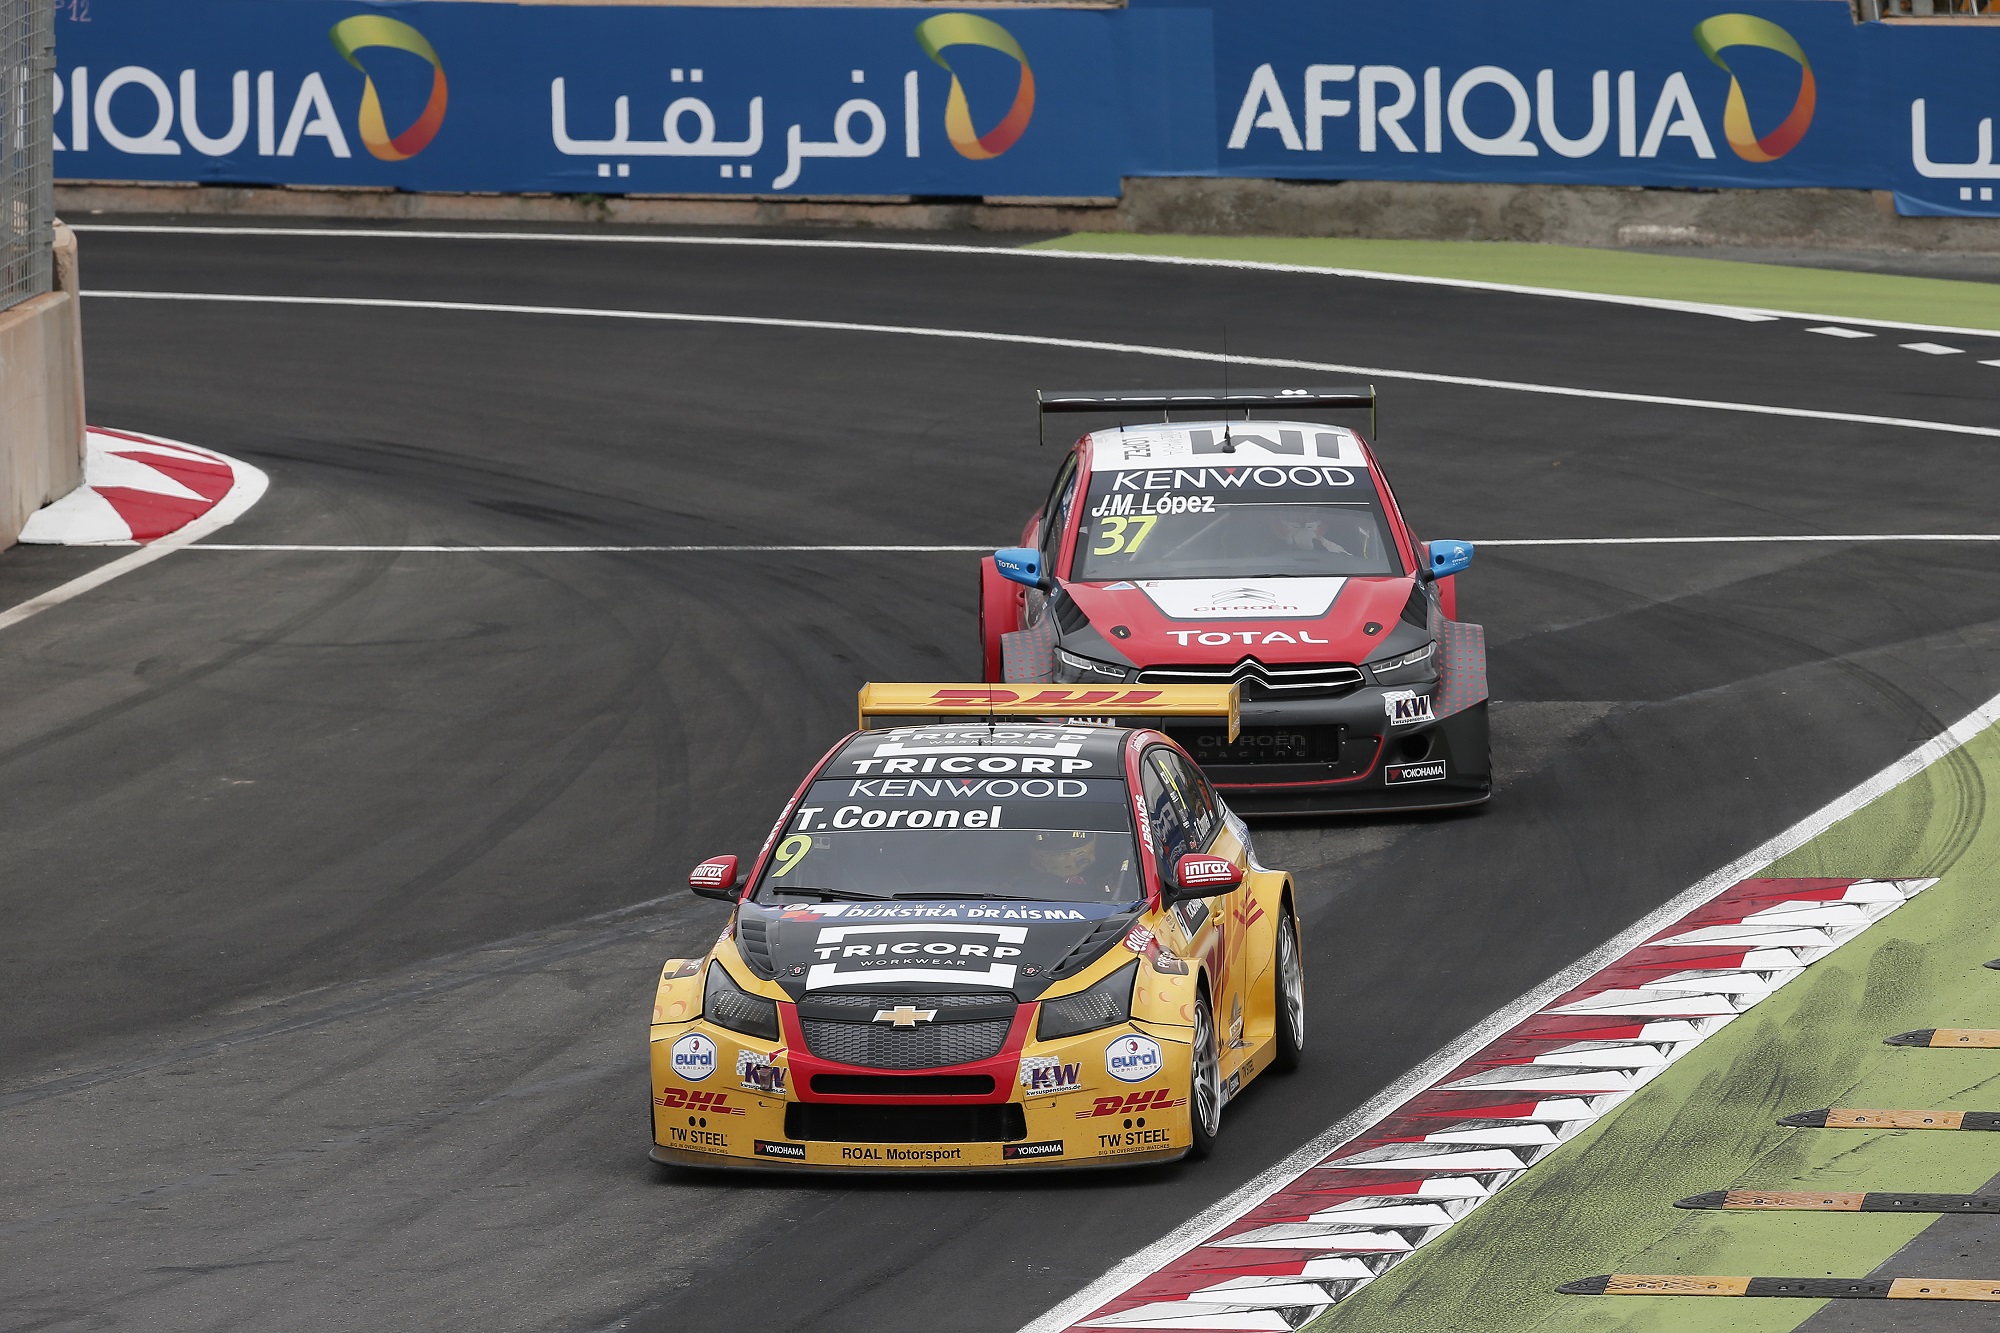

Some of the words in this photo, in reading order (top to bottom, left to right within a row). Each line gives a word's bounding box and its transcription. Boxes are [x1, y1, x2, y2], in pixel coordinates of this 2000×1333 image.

[1227, 63, 1717, 159] AFRIQUIA
[551, 69, 920, 190] افريقيا
[1112, 466, 1355, 492] KENWOOD
[1091, 493, 1136, 517] J.M.
[1141, 492, 1216, 516] López
[1093, 515, 1157, 556] 37
[997, 560, 1020, 570] TOTAL
[1166, 630, 1329, 646] TOTAL
[927, 689, 1165, 707] DHL
[1395, 697, 1429, 719] KW
[885, 731, 1089, 742] TRICORP
[852, 757, 1094, 775] TRICORP
[1401, 765, 1443, 779] YOKOHAMA
[848, 779, 1089, 798] KENWOOD
[771, 834, 813, 878] 9
[844, 907, 958, 918] DIJKSTRA
[967, 908, 1087, 920] DRAISMA
[814, 943, 1022, 960] TRICORP
[860, 958, 967, 966] WORKWEAR
[675, 1052, 713, 1066] eurol
[1111, 1050, 1157, 1069] eurol
[1032, 1063, 1081, 1090] KW
[1026, 1084, 1082, 1097] kwsuspensions.de
[663, 1087, 734, 1115] DHL
[1090, 1088, 1175, 1118] DHL
[670, 1127, 688, 1142] TW
[690, 1130, 728, 1147] STEEL
[1098, 1134, 1121, 1147] TW
[1125, 1129, 1170, 1145] STEEL
[765, 1144, 804, 1156] YOKOHAMA
[842, 1147, 882, 1160] ROAL
[886, 1147, 961, 1162] Motorsport
[1017, 1143, 1062, 1155] YOKOHAMA
